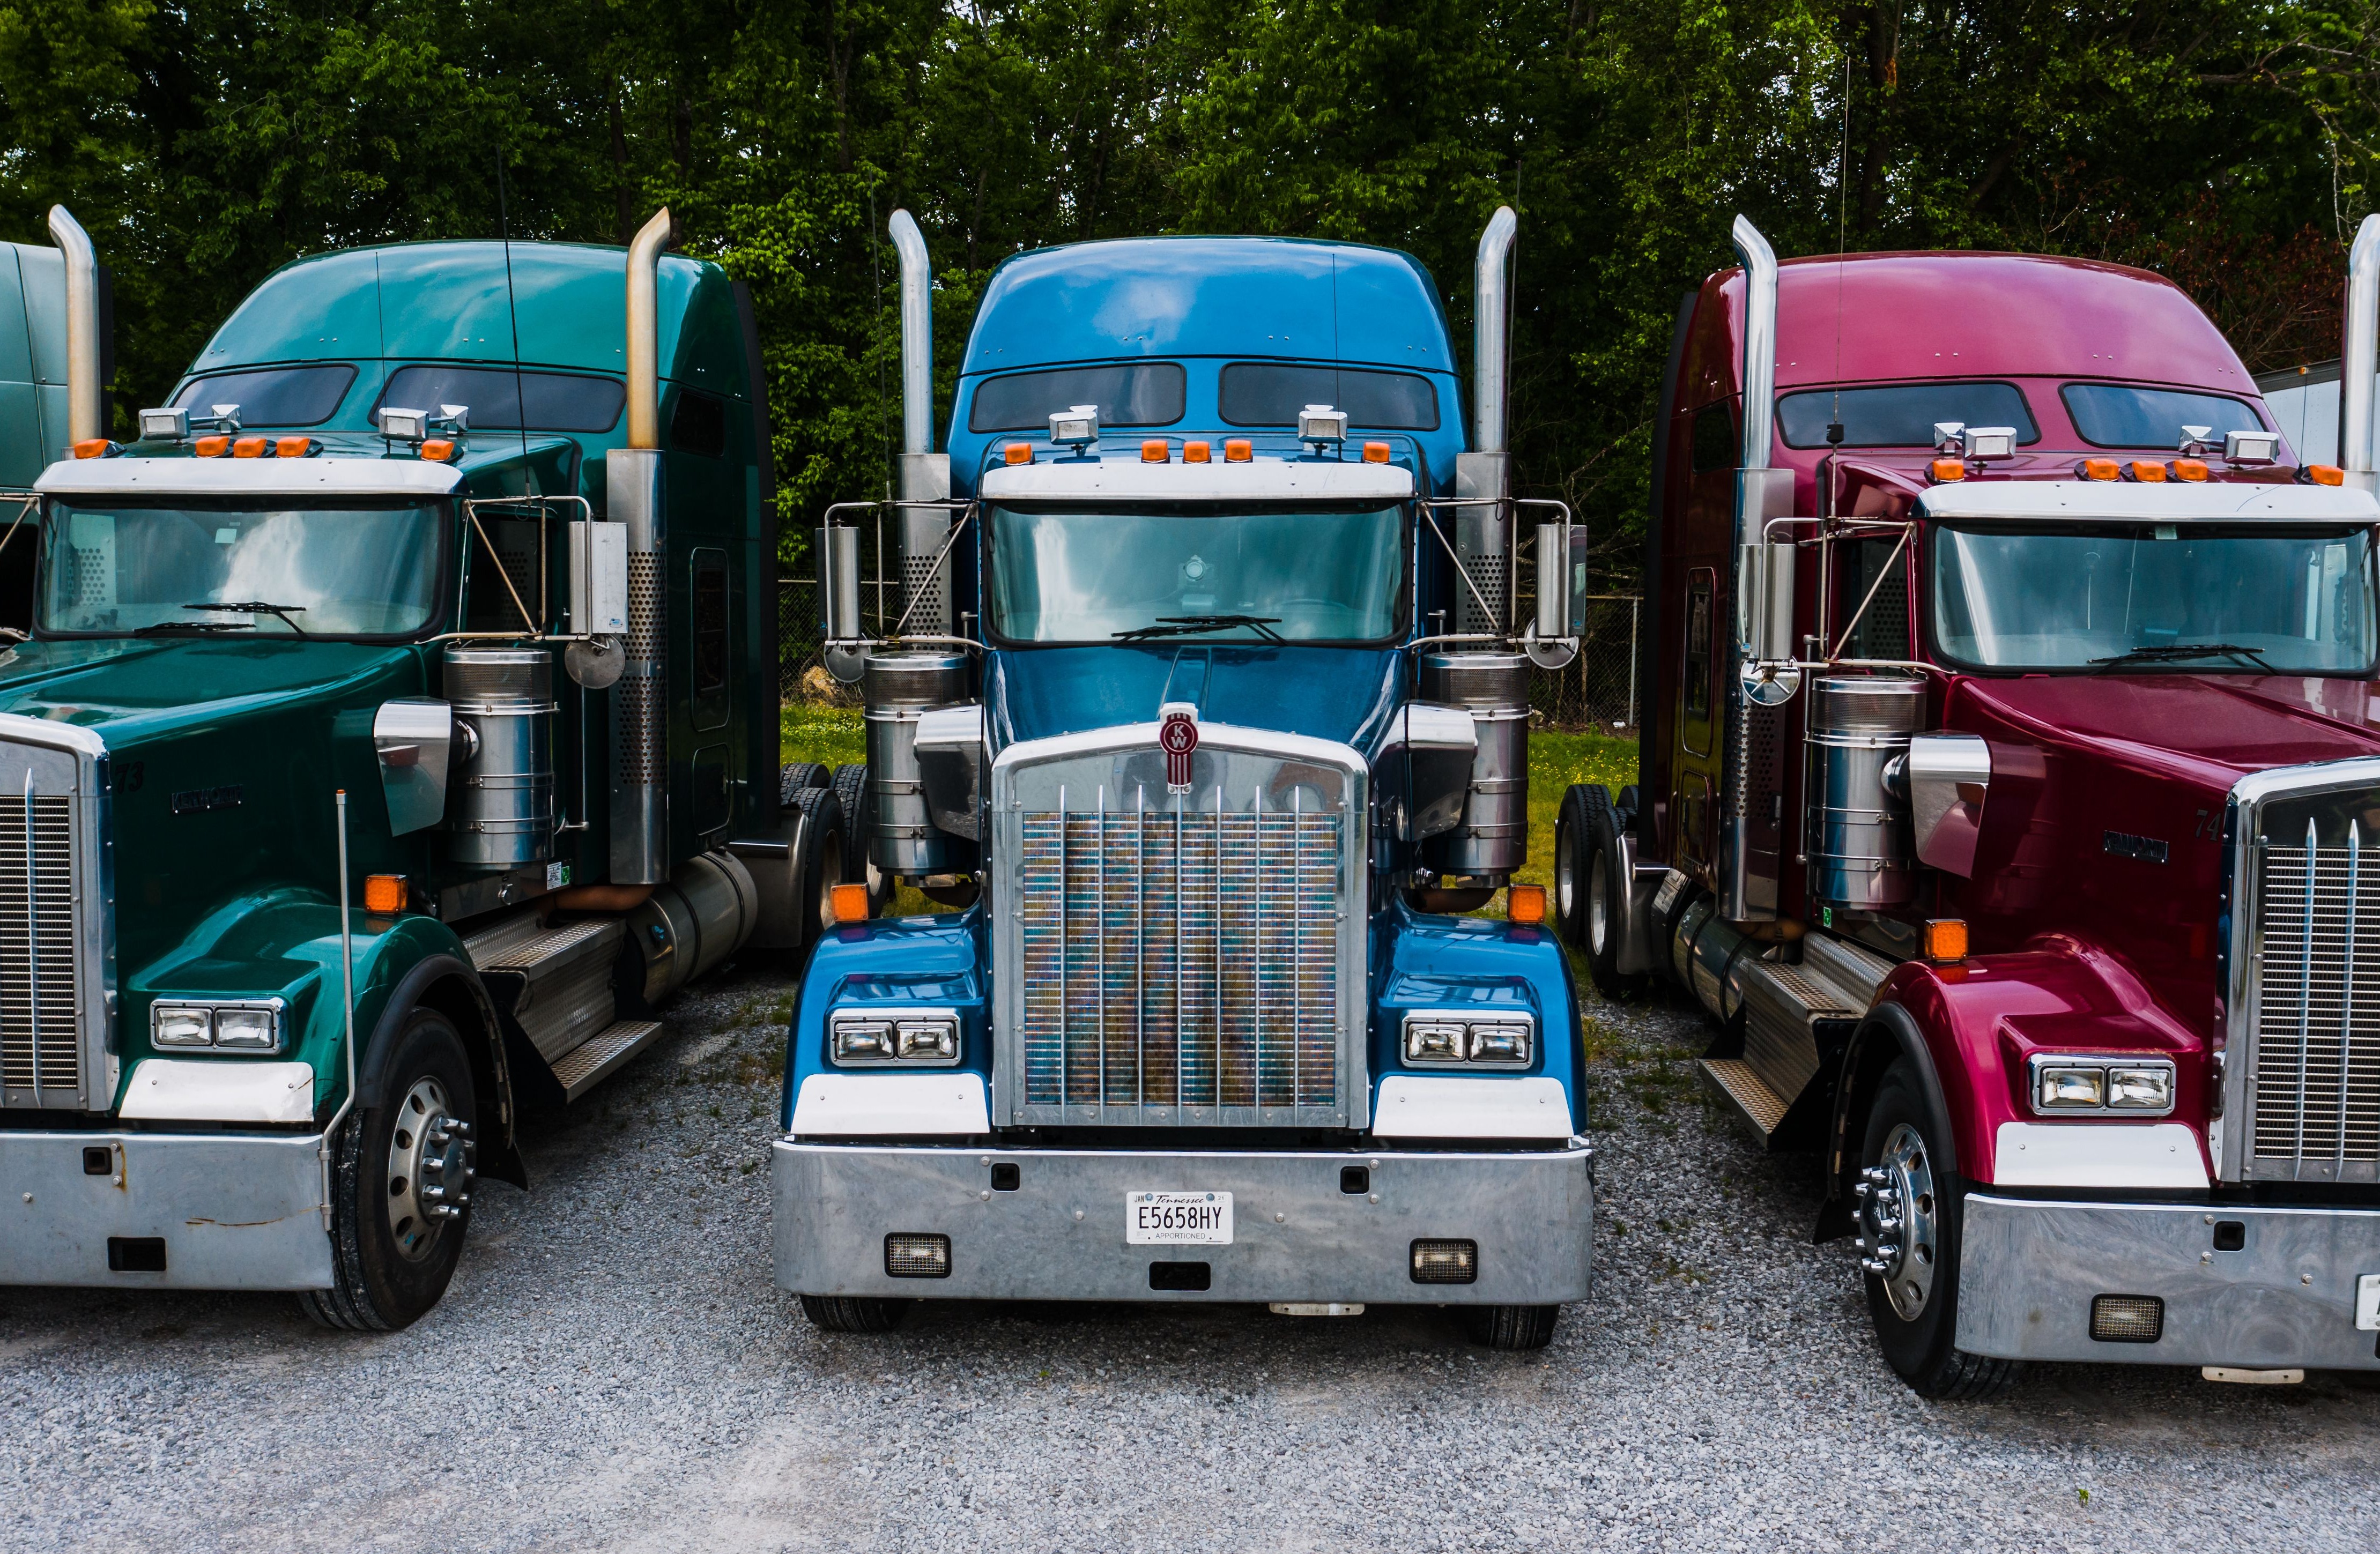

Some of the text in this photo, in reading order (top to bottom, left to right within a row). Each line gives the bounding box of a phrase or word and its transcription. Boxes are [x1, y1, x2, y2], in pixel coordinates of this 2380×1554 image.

[1170, 737, 1187, 748] W
[1174, 725, 1184, 737] K
[115, 761, 144, 794] 73
[172, 784, 244, 810] KENWORTH
[2195, 809, 2222, 841] 74
[1156, 1195, 1204, 1204] Tennessee
[1139, 1206, 1222, 1229] E5658HY
